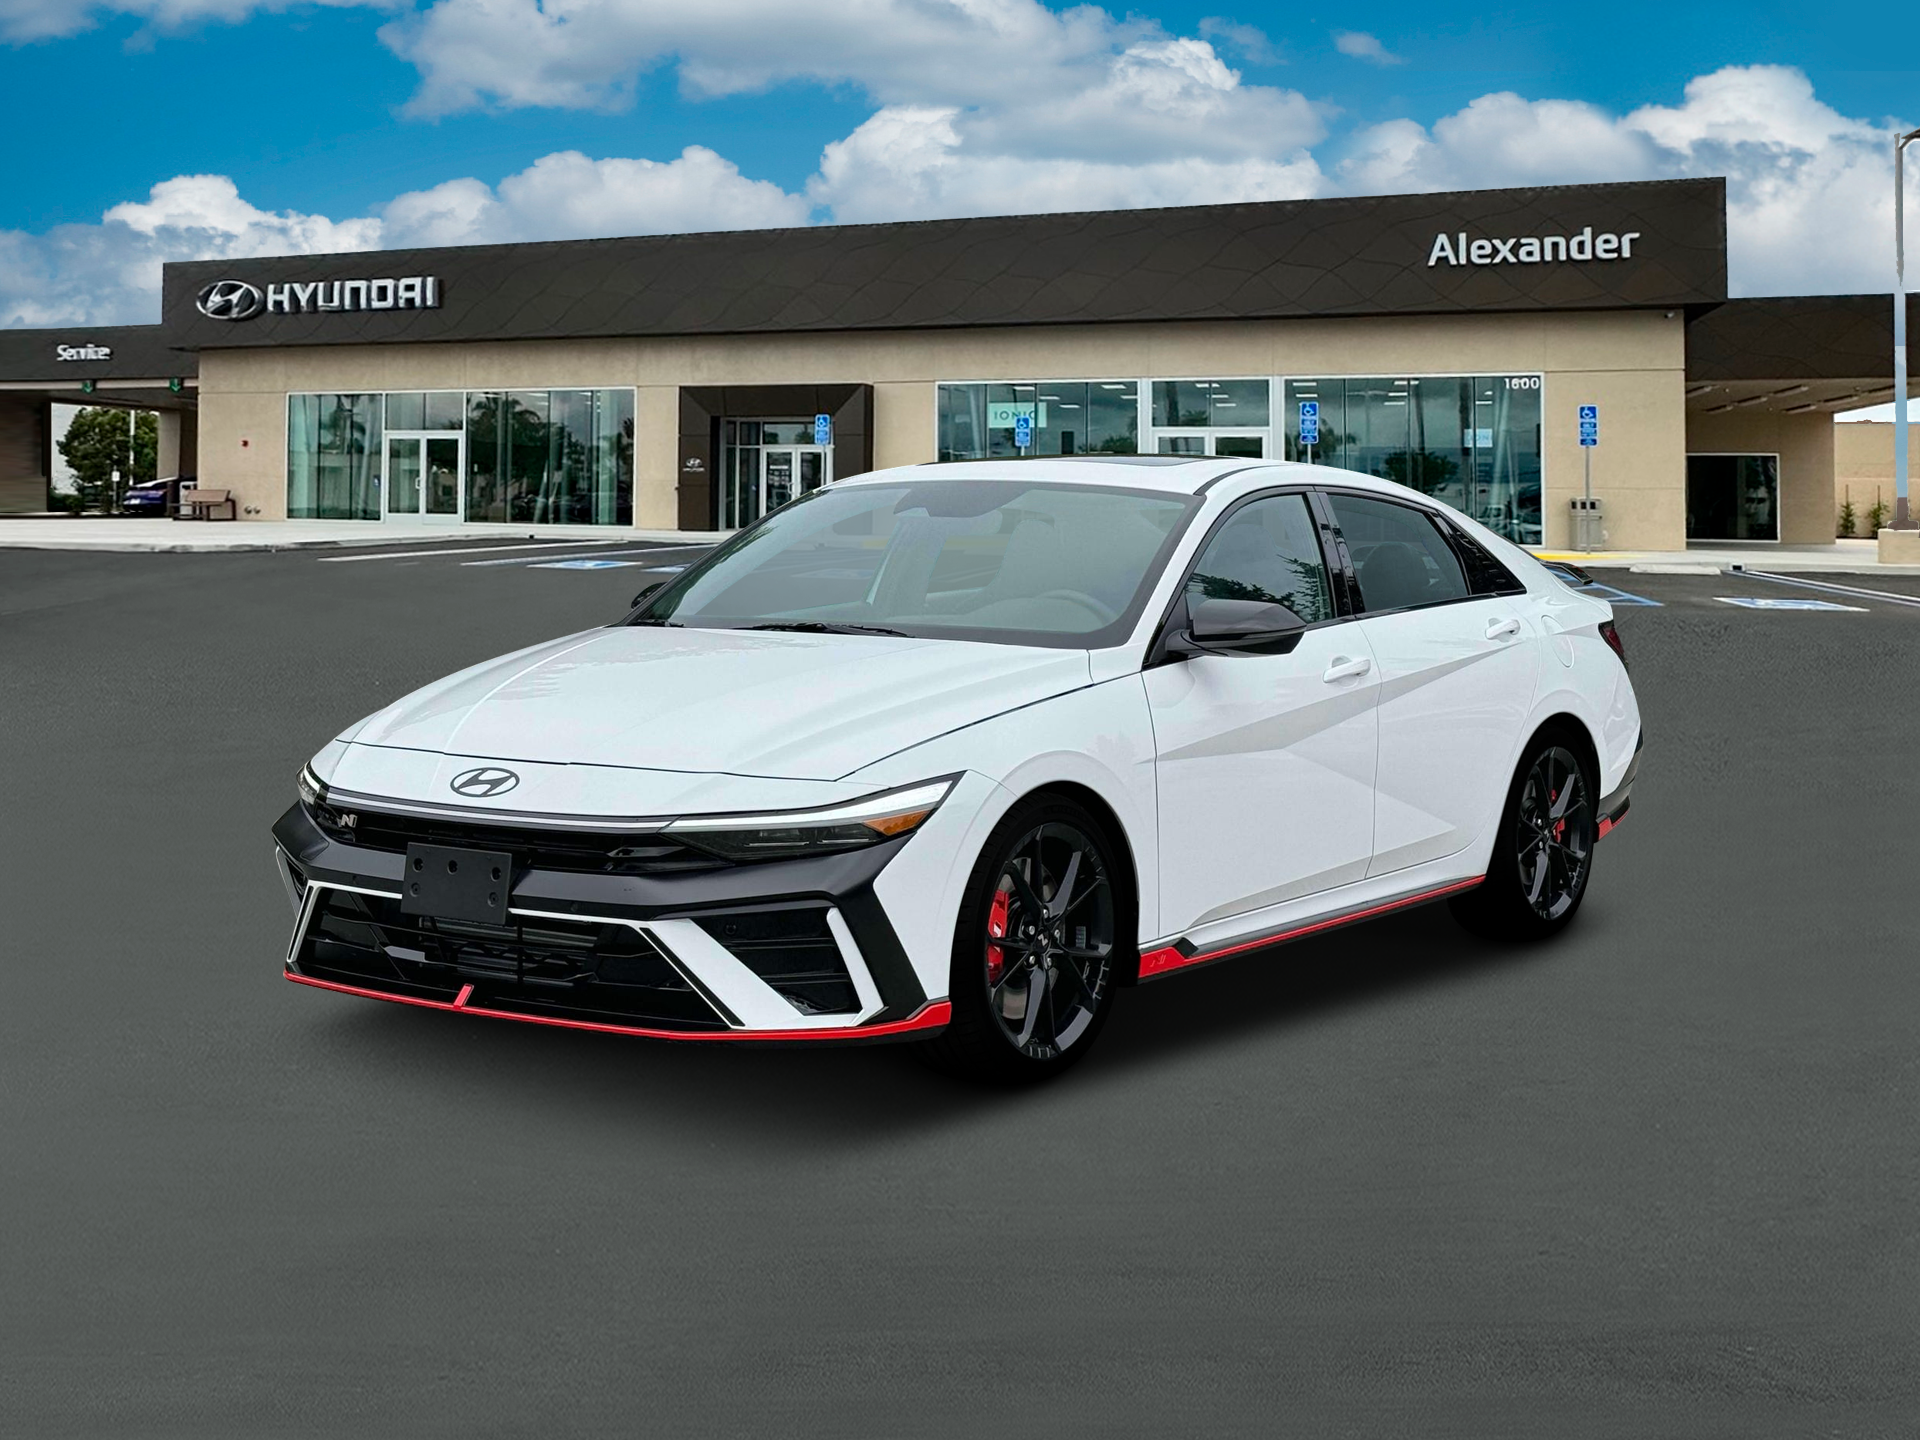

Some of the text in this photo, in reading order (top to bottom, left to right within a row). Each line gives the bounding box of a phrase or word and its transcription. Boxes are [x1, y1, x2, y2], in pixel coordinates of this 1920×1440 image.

[1427, 226, 1641, 267] Alexander
[266, 275, 440, 313] HYUNDAI
[56, 343, 111, 361] Service
[1503, 377, 1540, 390] 1600
